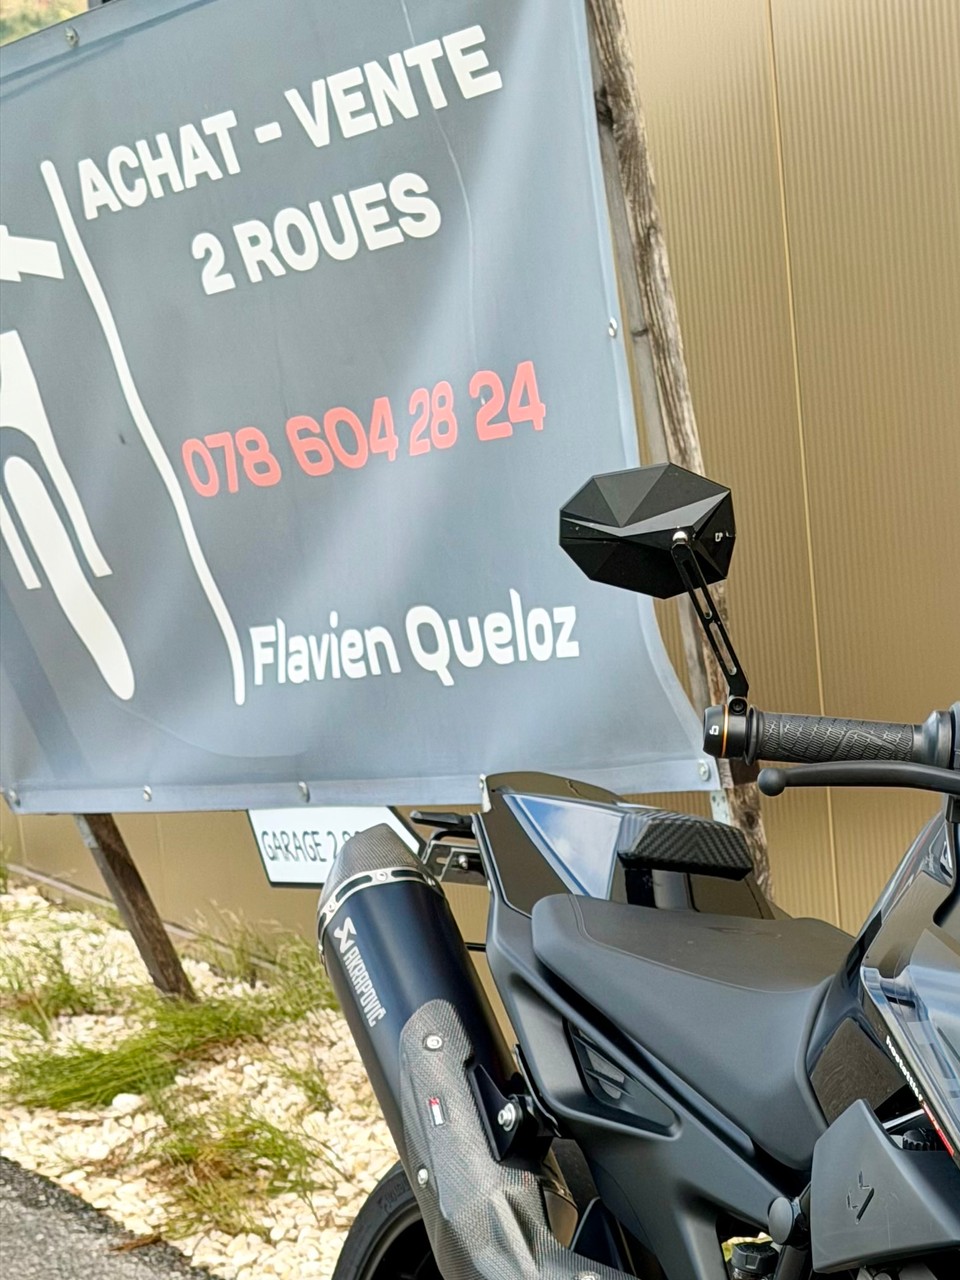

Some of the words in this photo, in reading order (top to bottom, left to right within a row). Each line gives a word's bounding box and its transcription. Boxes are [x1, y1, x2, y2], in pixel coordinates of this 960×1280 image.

[78, 109, 241, 220] ACHAT
[284, 24, 503, 148] VENTE
[191, 232, 236, 295] 2
[232, 172, 441, 283] ROUES
[182, 427, 281, 497] 078
[285, 397, 397, 476] 604
[408, 381, 458, 455] 28
[469, 361, 546, 441] 24
[249, 611, 401, 687] Flavien
[405, 588, 580, 687] Queloz
[261, 830, 327, 863] GARAGE
